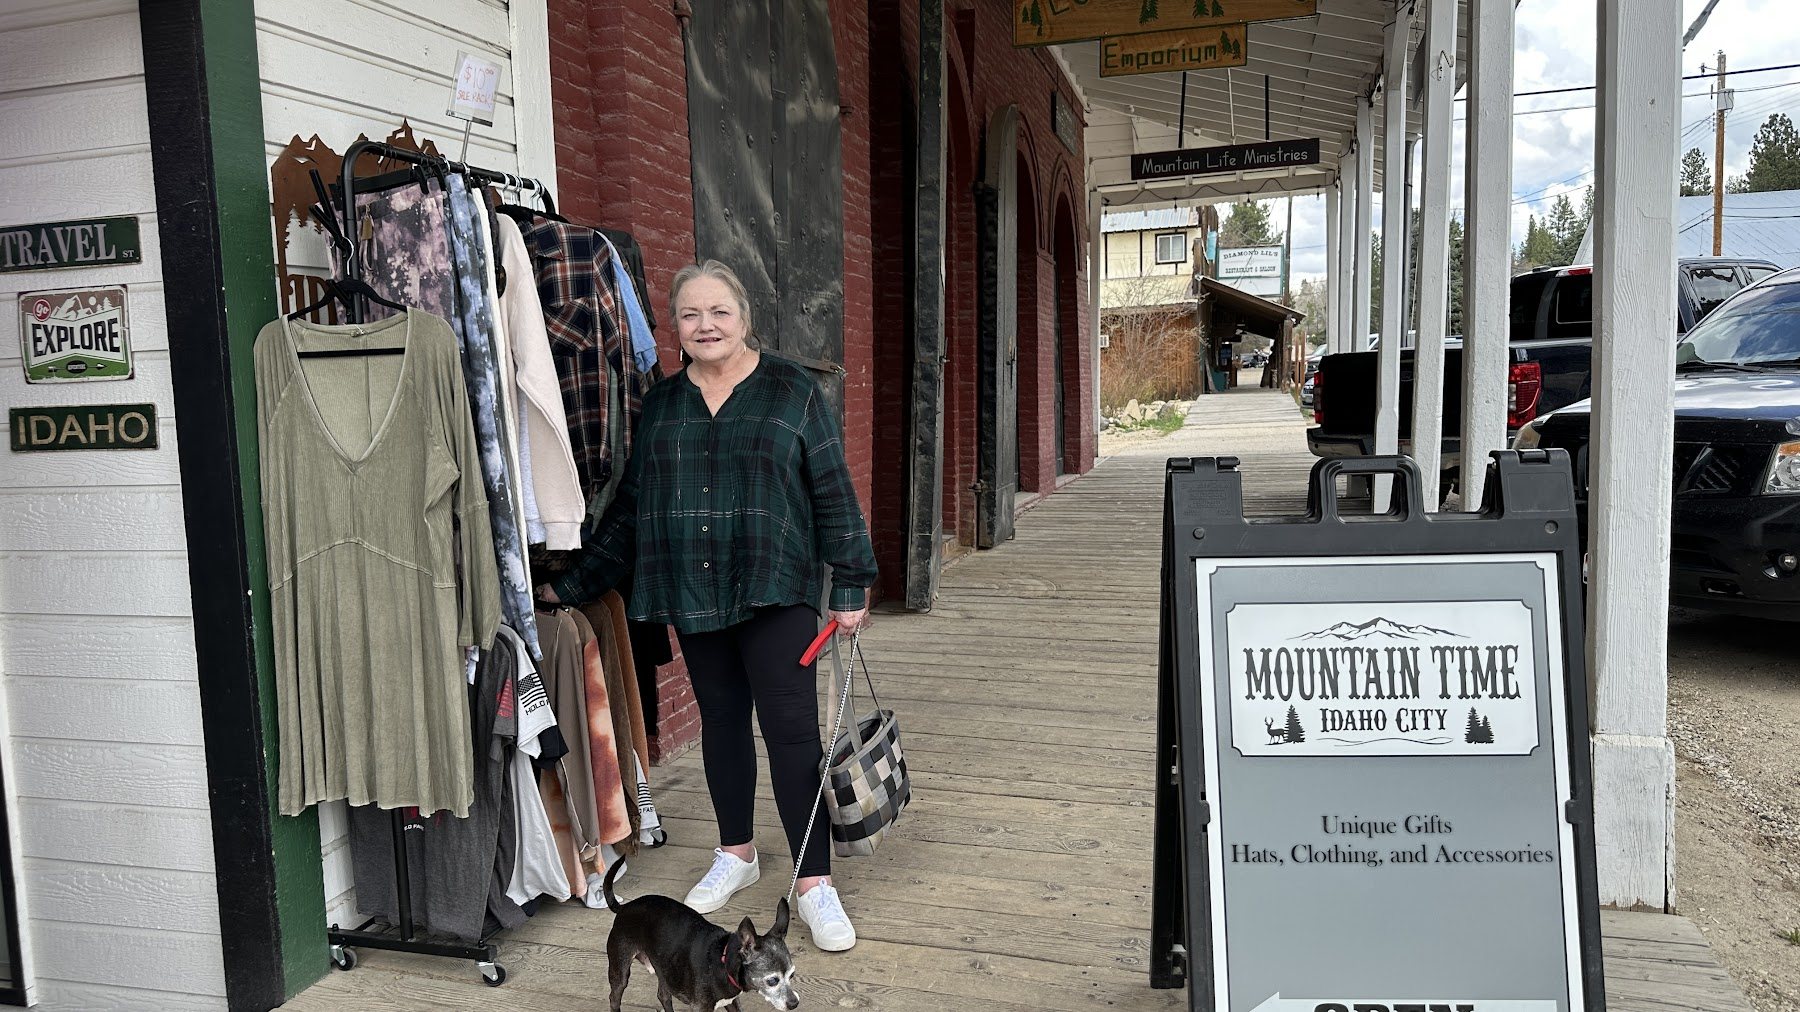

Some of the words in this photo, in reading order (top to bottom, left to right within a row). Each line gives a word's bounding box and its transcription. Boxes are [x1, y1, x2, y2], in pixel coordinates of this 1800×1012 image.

[1104, 43, 1217, 69] Emporium
[457, 89, 472, 101] SALE
[1142, 155, 1200, 175] Mountain
[1206, 152, 1237, 169] Life
[1243, 146, 1308, 165] Ministries
[0, 223, 117, 268] TRAVEL
[122, 250, 135, 258] ST
[1223, 250, 1259, 259] DIAMOND
[36, 303, 50, 317] go
[32, 317, 121, 357] EXPLORE
[18, 411, 149, 445] IDAHO
[1243, 646, 1421, 701] MOUNTAIN
[1430, 645, 1522, 700] TIME
[525, 700, 546, 716] HOLD
[1320, 708, 1387, 733] IDAHO
[1395, 708, 1448, 732] CITY
[1321, 815, 1397, 838] Unique
[1404, 815, 1452, 835] Gifts
[1231, 844, 1284, 865] Hats,
[1291, 844, 1383, 867] Clothing,
[1390, 845, 1427, 863] and
[1435, 844, 1554, 863] Accessories
